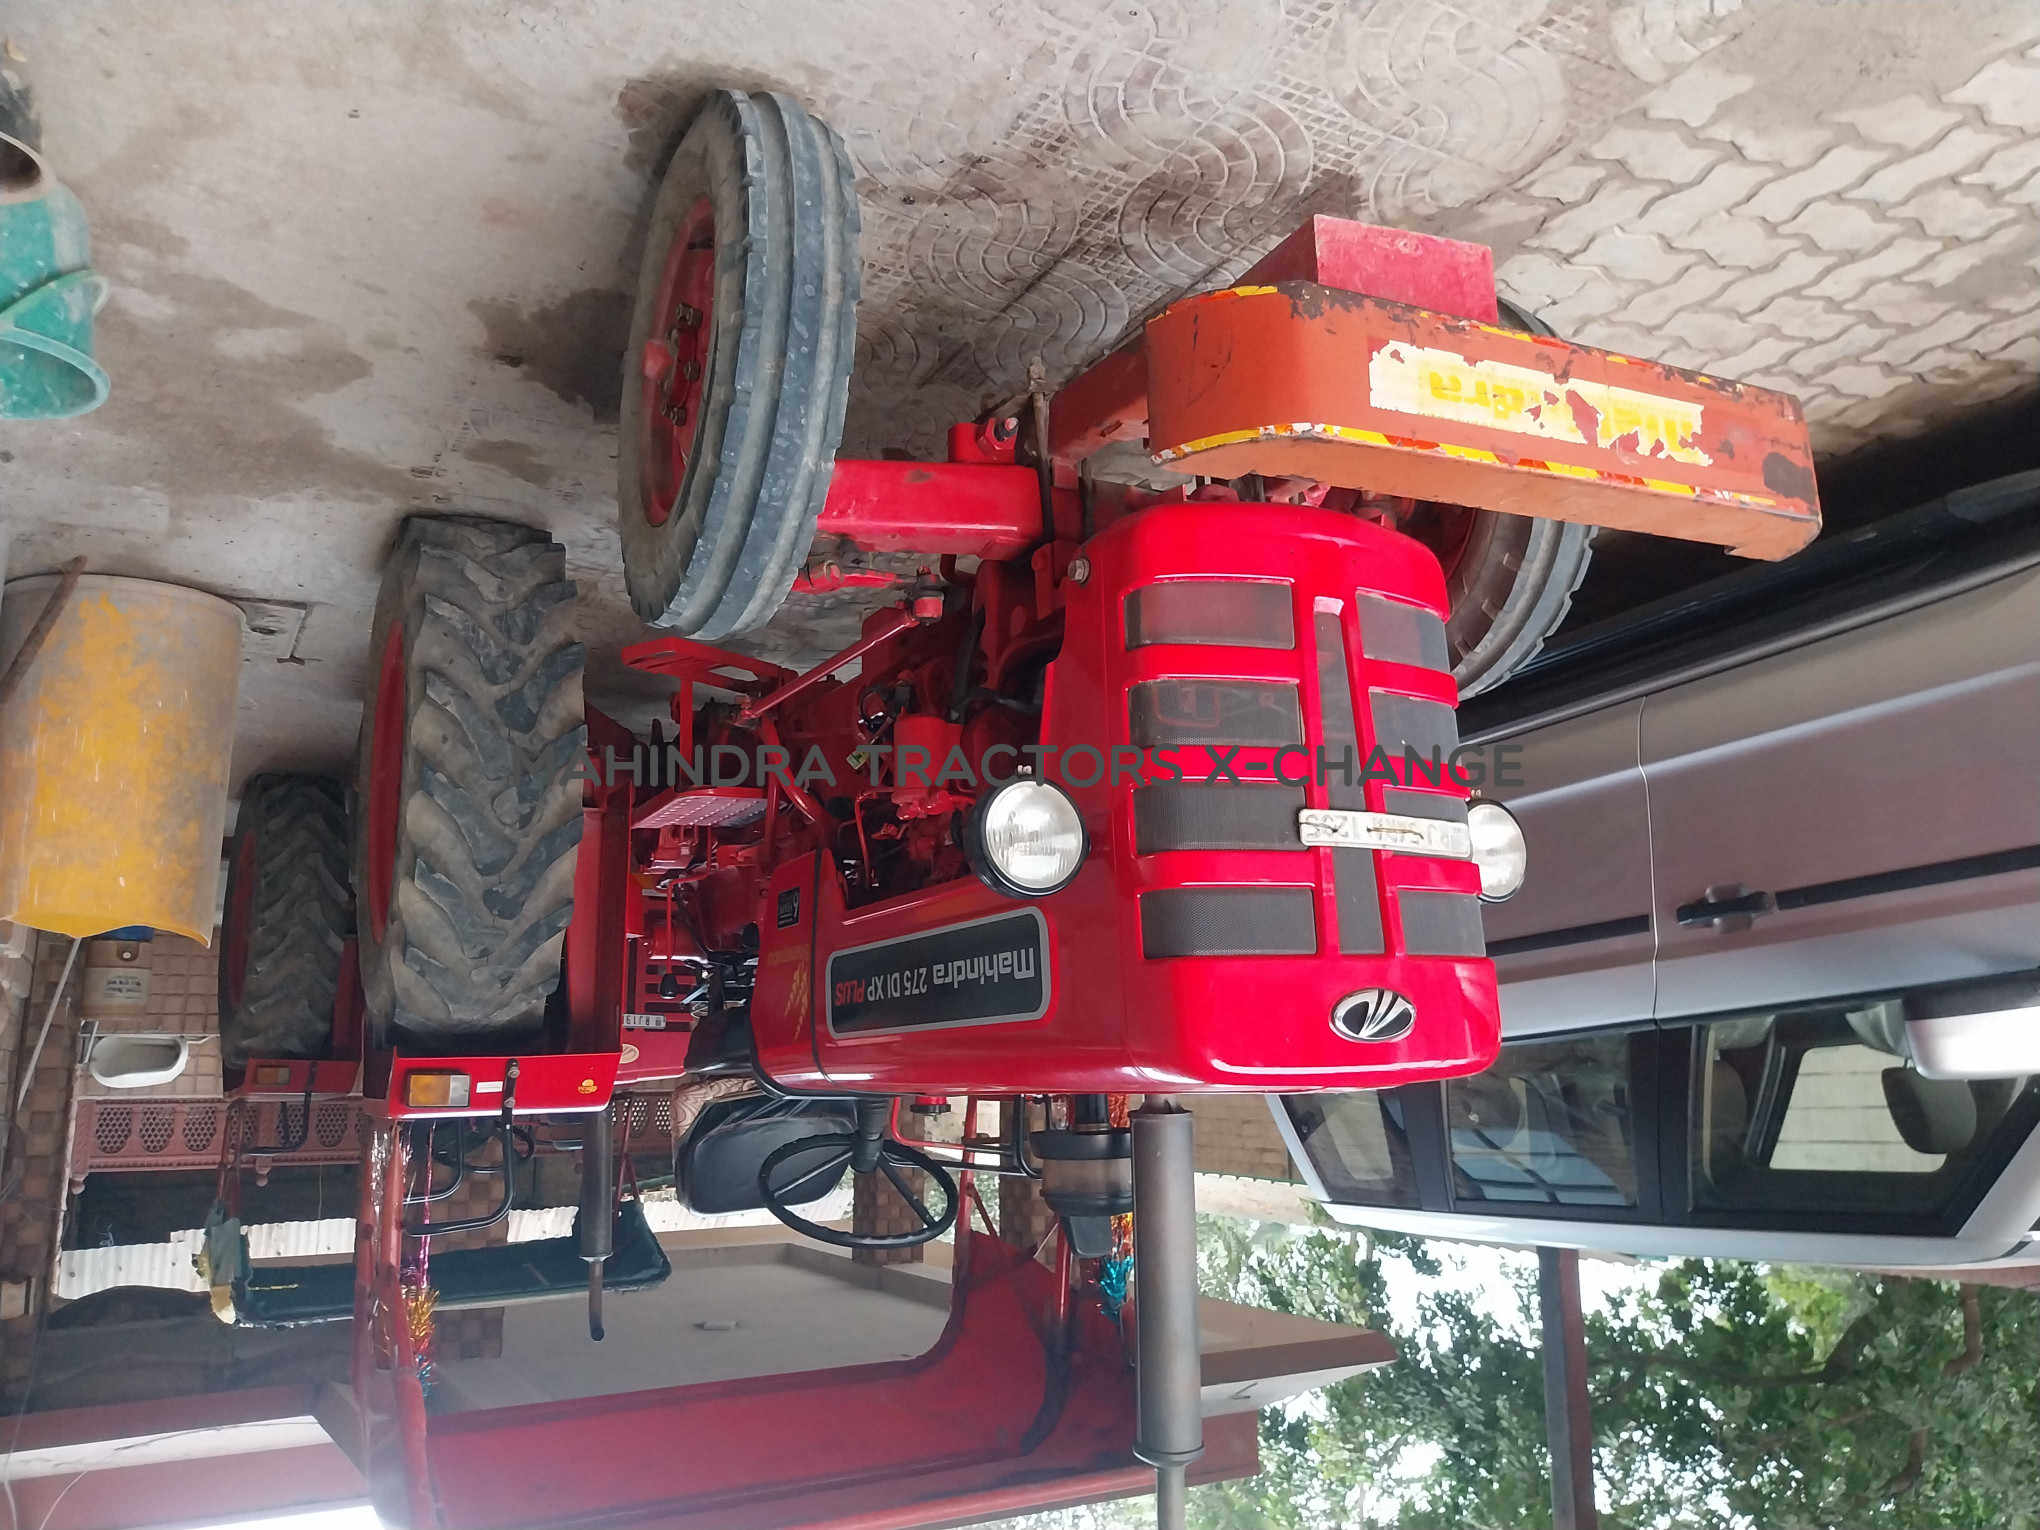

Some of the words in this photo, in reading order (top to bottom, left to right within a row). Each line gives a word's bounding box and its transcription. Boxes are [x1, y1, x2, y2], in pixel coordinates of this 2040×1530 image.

[904, 967, 928, 996] 275
[932, 947, 1035, 989] Mahindra
[834, 978, 865, 1006] PLUS
[867, 974, 885, 1001] XP
[887, 972, 900, 998] DI
